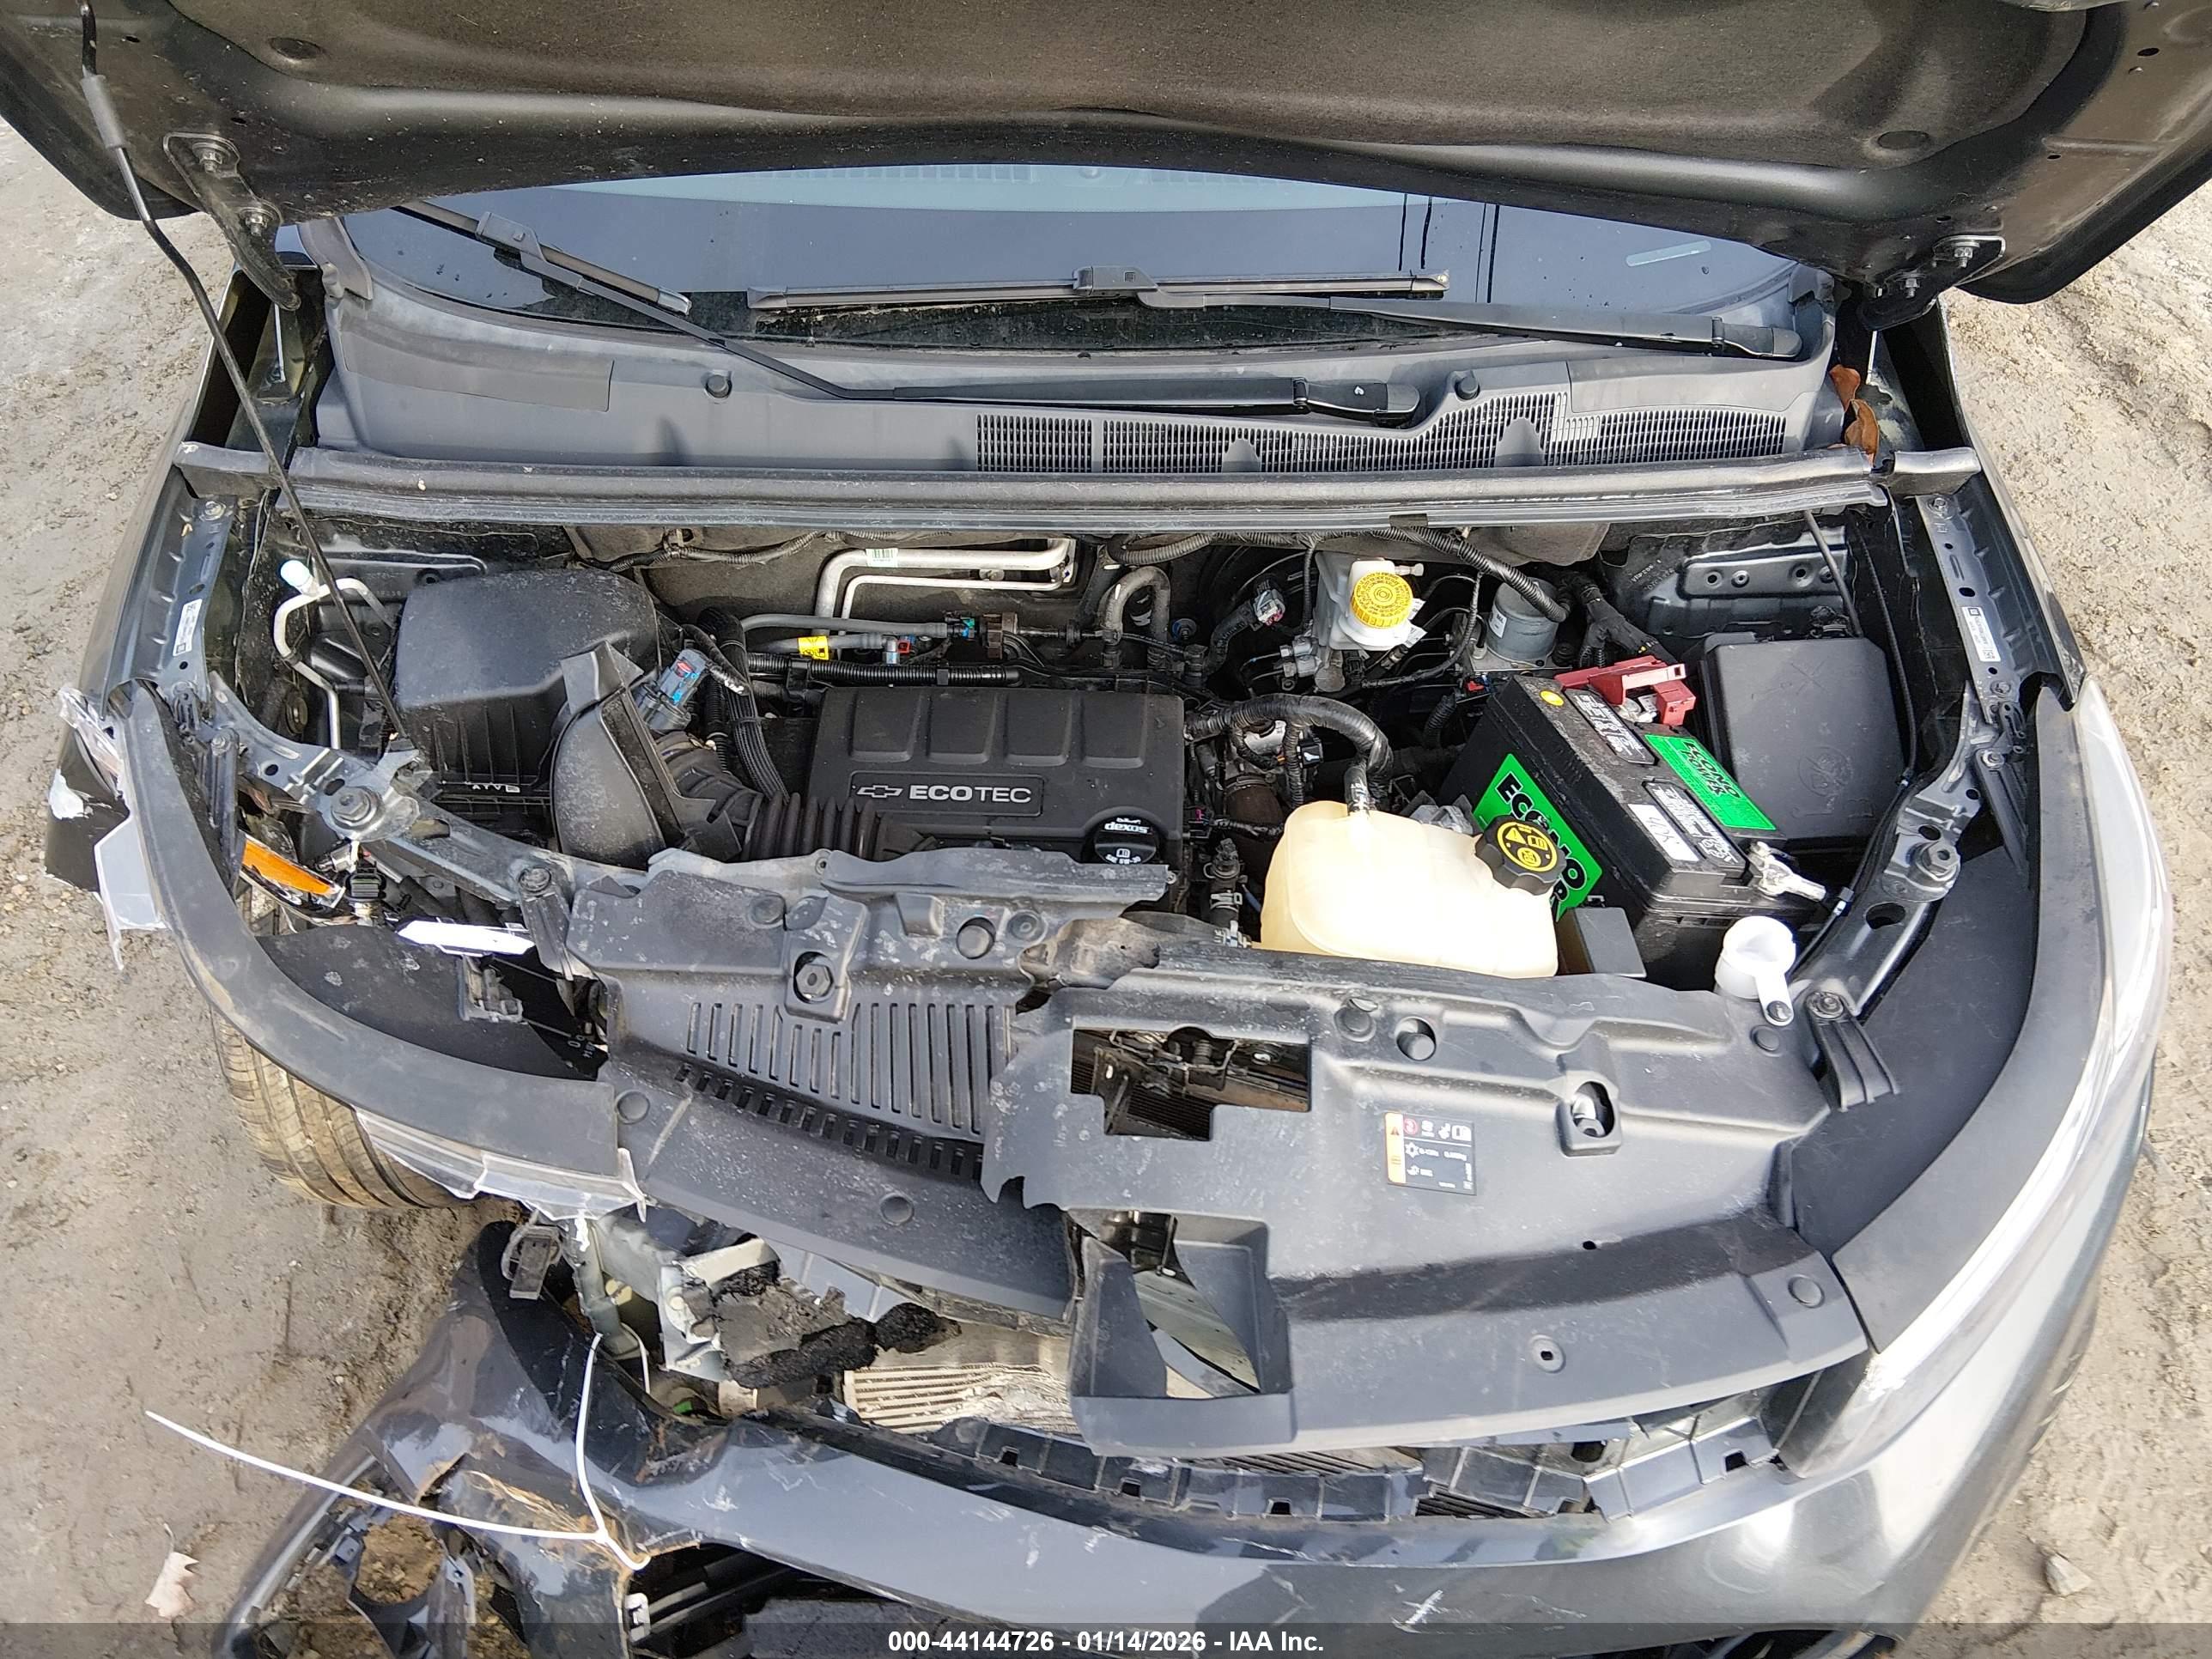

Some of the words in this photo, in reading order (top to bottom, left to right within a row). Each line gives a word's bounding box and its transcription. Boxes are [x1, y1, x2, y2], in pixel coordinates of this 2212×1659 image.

[1682, 740, 1742, 799] ECONO
[908, 784, 1031, 804] ECOTEC
[1103, 821, 1150, 835] dexos
